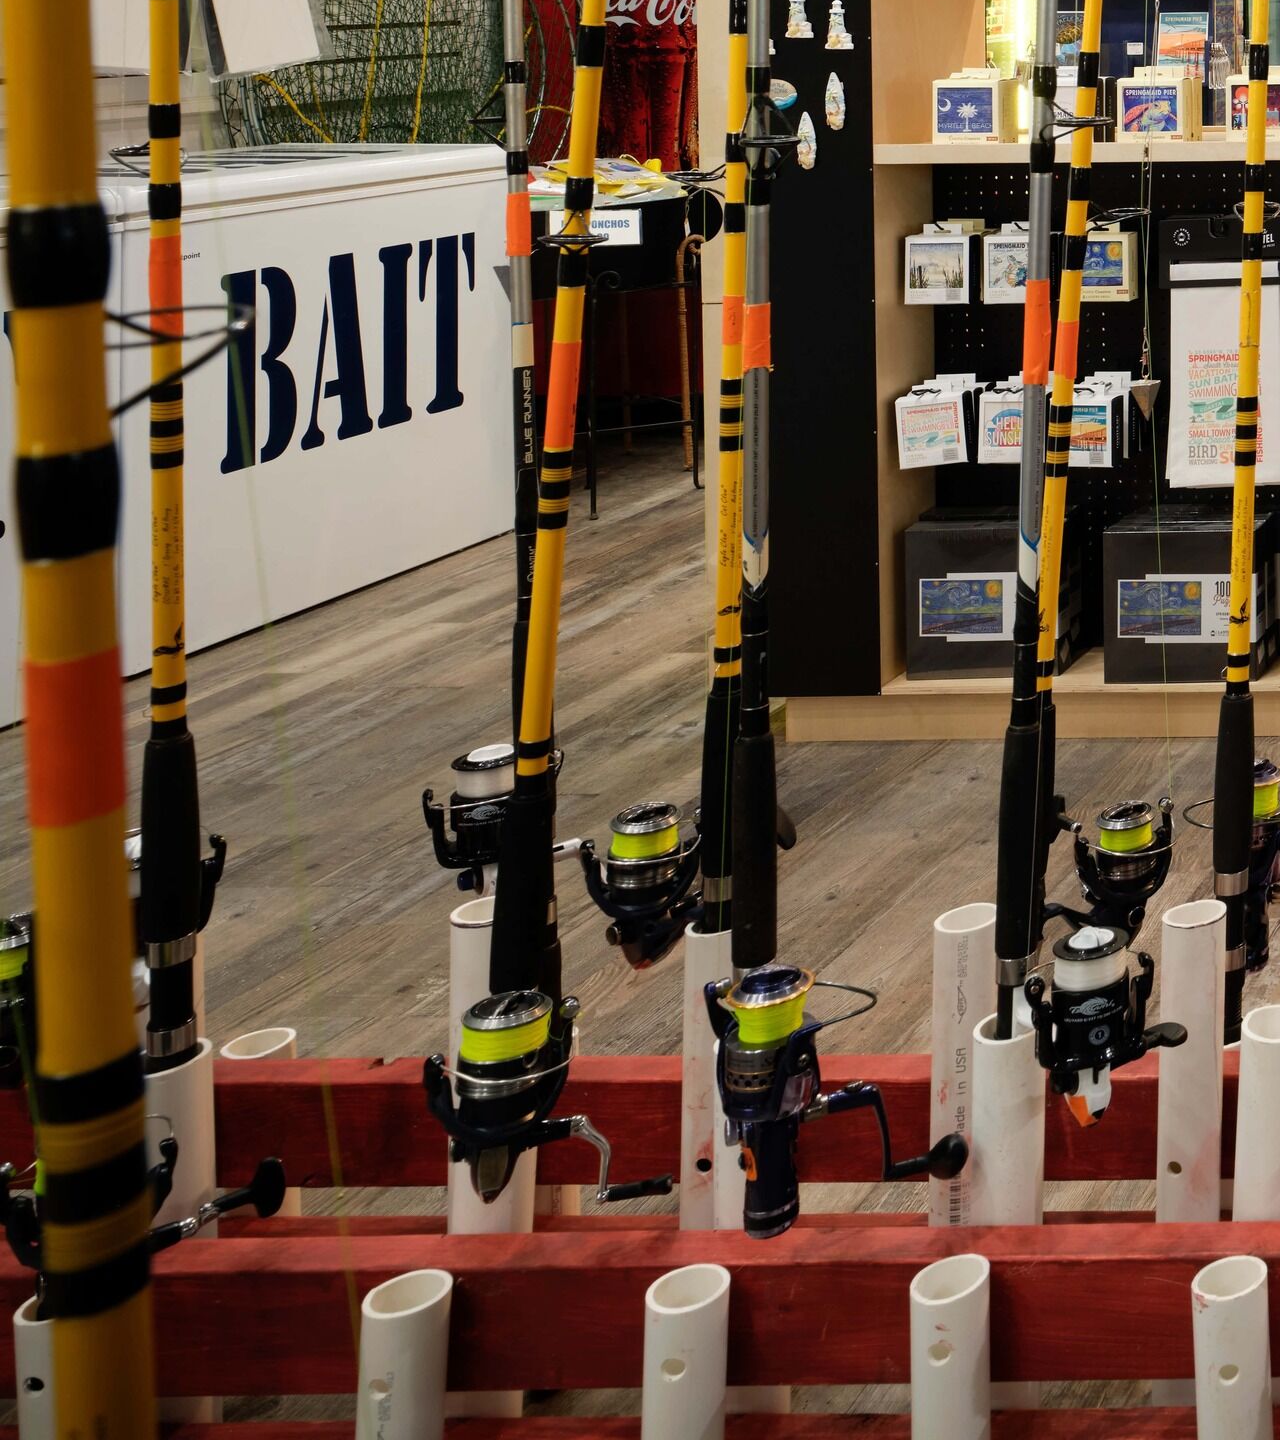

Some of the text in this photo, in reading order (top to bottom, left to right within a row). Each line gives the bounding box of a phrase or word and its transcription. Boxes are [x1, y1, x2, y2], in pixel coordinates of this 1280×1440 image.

[591, 219, 630, 229] ONCHOS
[221, 232, 475, 474] BAIT
[1188, 354, 1239, 363] SPRINGMAID
[1188, 368, 1231, 380] VACATION
[1188, 379, 1211, 390] SUN
[1189, 383, 1236, 398] SWIMMING
[523, 369, 532, 424] RUNNER
[996, 416, 1022, 429] HELL
[986, 432, 1022, 446] SUNSH
[1188, 429, 1231, 438] SMALL TOWN
[524, 427, 533, 464] BLUE
[1188, 445, 1218, 458] BIRD
[1215, 580, 1231, 598] 100
[956, 1048, 966, 1096] in USA
